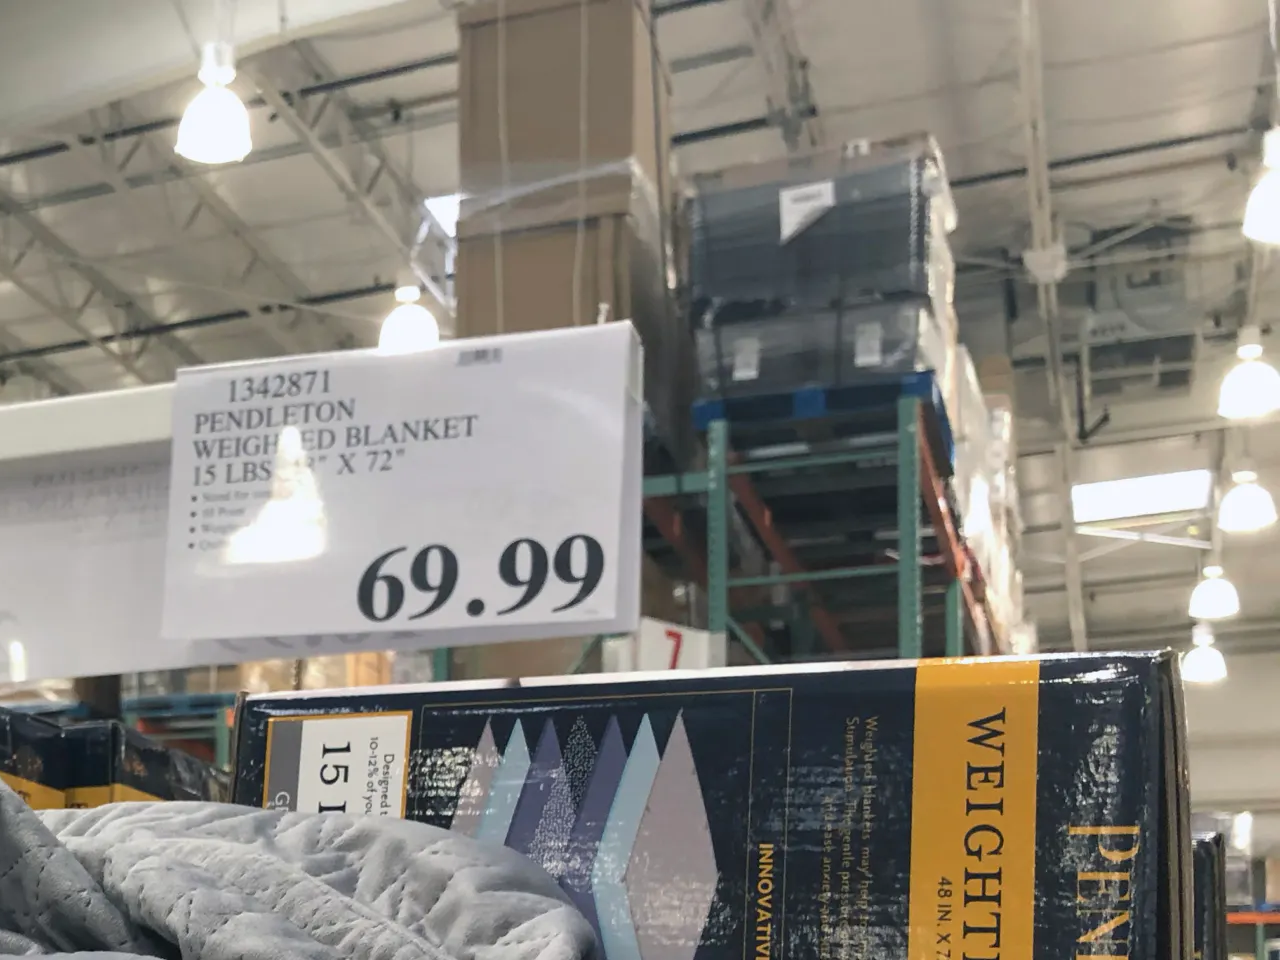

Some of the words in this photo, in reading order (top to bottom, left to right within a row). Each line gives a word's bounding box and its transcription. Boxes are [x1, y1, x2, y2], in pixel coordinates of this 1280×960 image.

[229, 370, 330, 403] 1342871
[194, 398, 357, 434] PENDLETON
[193, 428, 336, 459] WEIGHED
[346, 415, 479, 448] BLANKET
[193, 465, 217, 487] 15
[336, 452, 356, 476] X
[357, 534, 605, 624] 69.99
[665, 628, 683, 670] 7
[320, 741, 352, 786] 15
[367, 736, 379, 778] 10-12%
[859, 716, 879, 780] Weighted
[366, 781, 378, 794] of
[378, 753, 395, 809] Designed
[362, 794, 373, 814] you
[861, 785, 877, 840] blankets
[838, 827, 856, 868] gentle
[856, 846, 871, 874] may
[937, 876, 953, 898] 48
[936, 904, 952, 927] IN.
[936, 932, 951, 944] X
